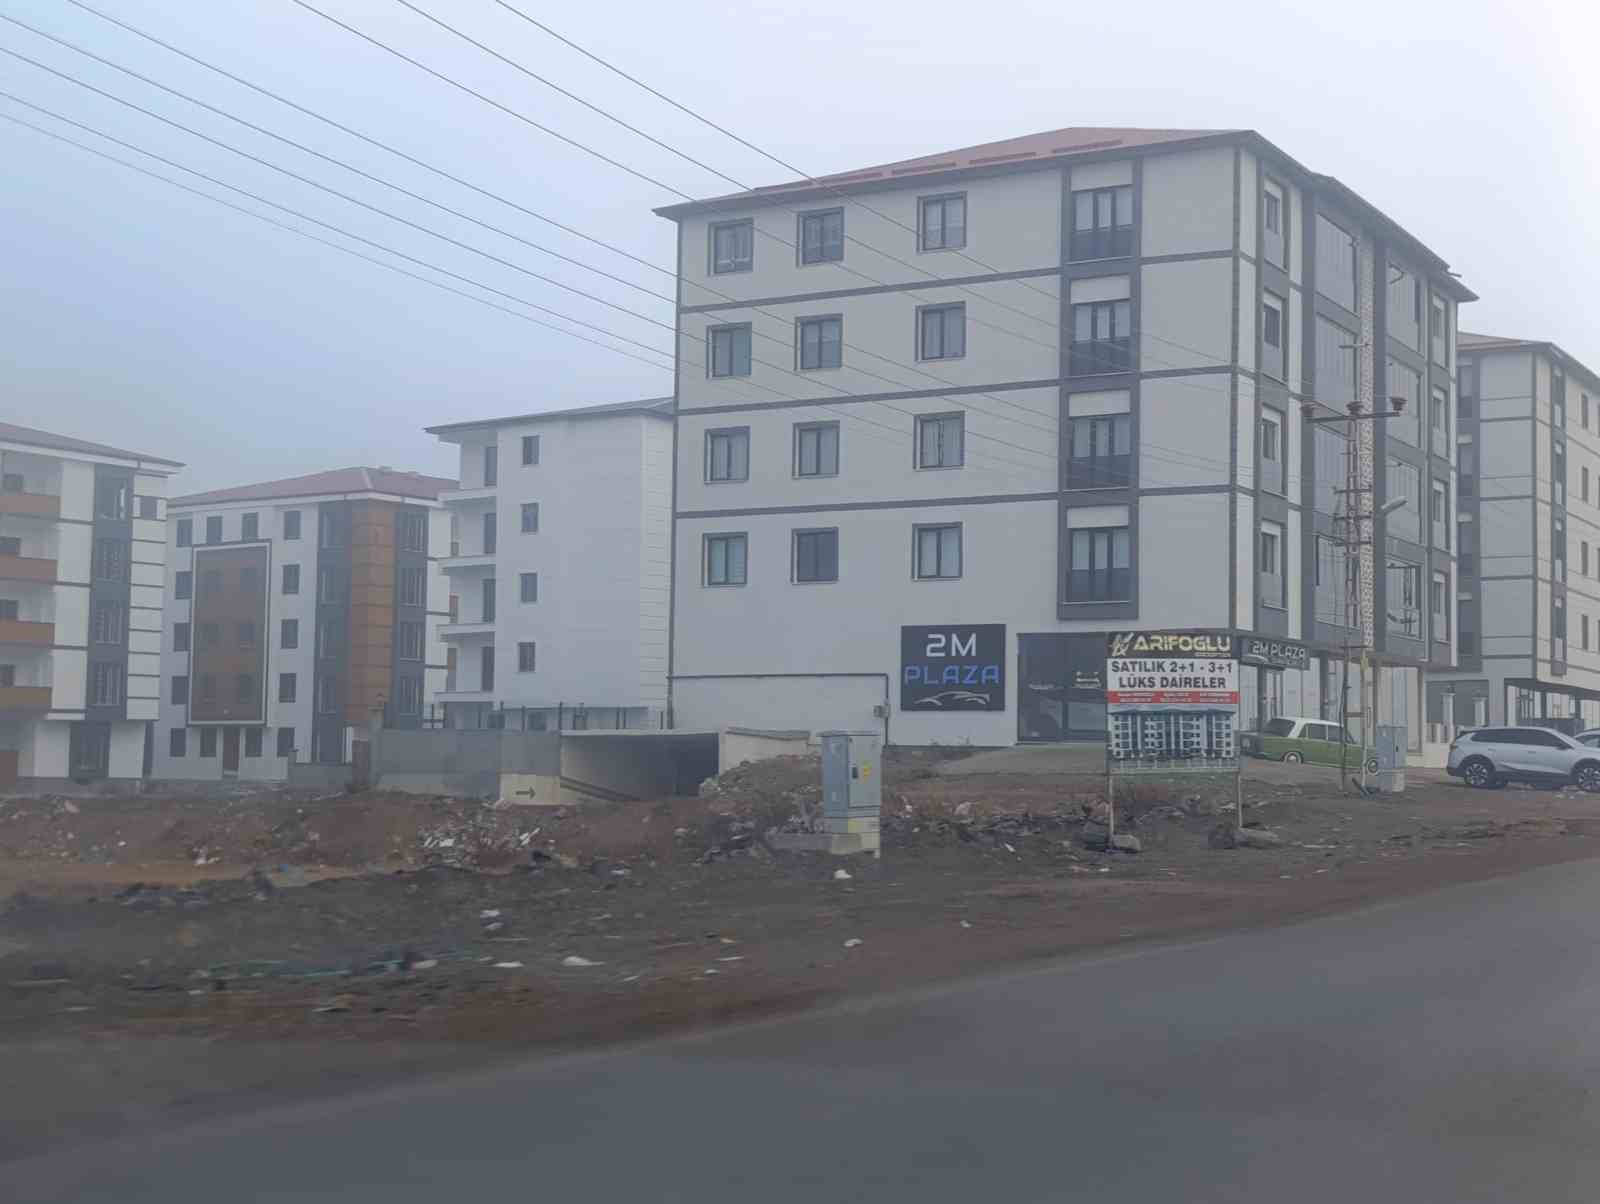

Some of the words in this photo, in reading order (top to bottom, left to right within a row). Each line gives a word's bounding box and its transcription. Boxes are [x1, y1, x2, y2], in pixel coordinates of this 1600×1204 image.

[925, 632, 977, 656] 2M
[1252, 640, 1269, 655] 2M
[1271, 643, 1306, 659] PLAZA
[904, 664, 1000, 685] PLAZA
[1111, 661, 1166, 673] SATILIK
[1169, 661, 1194, 673] 2+1
[1208, 662, 1232, 673] 3+1
[1119, 674, 1157, 688] LÜKS
[1160, 674, 1226, 688] DAİRELER
